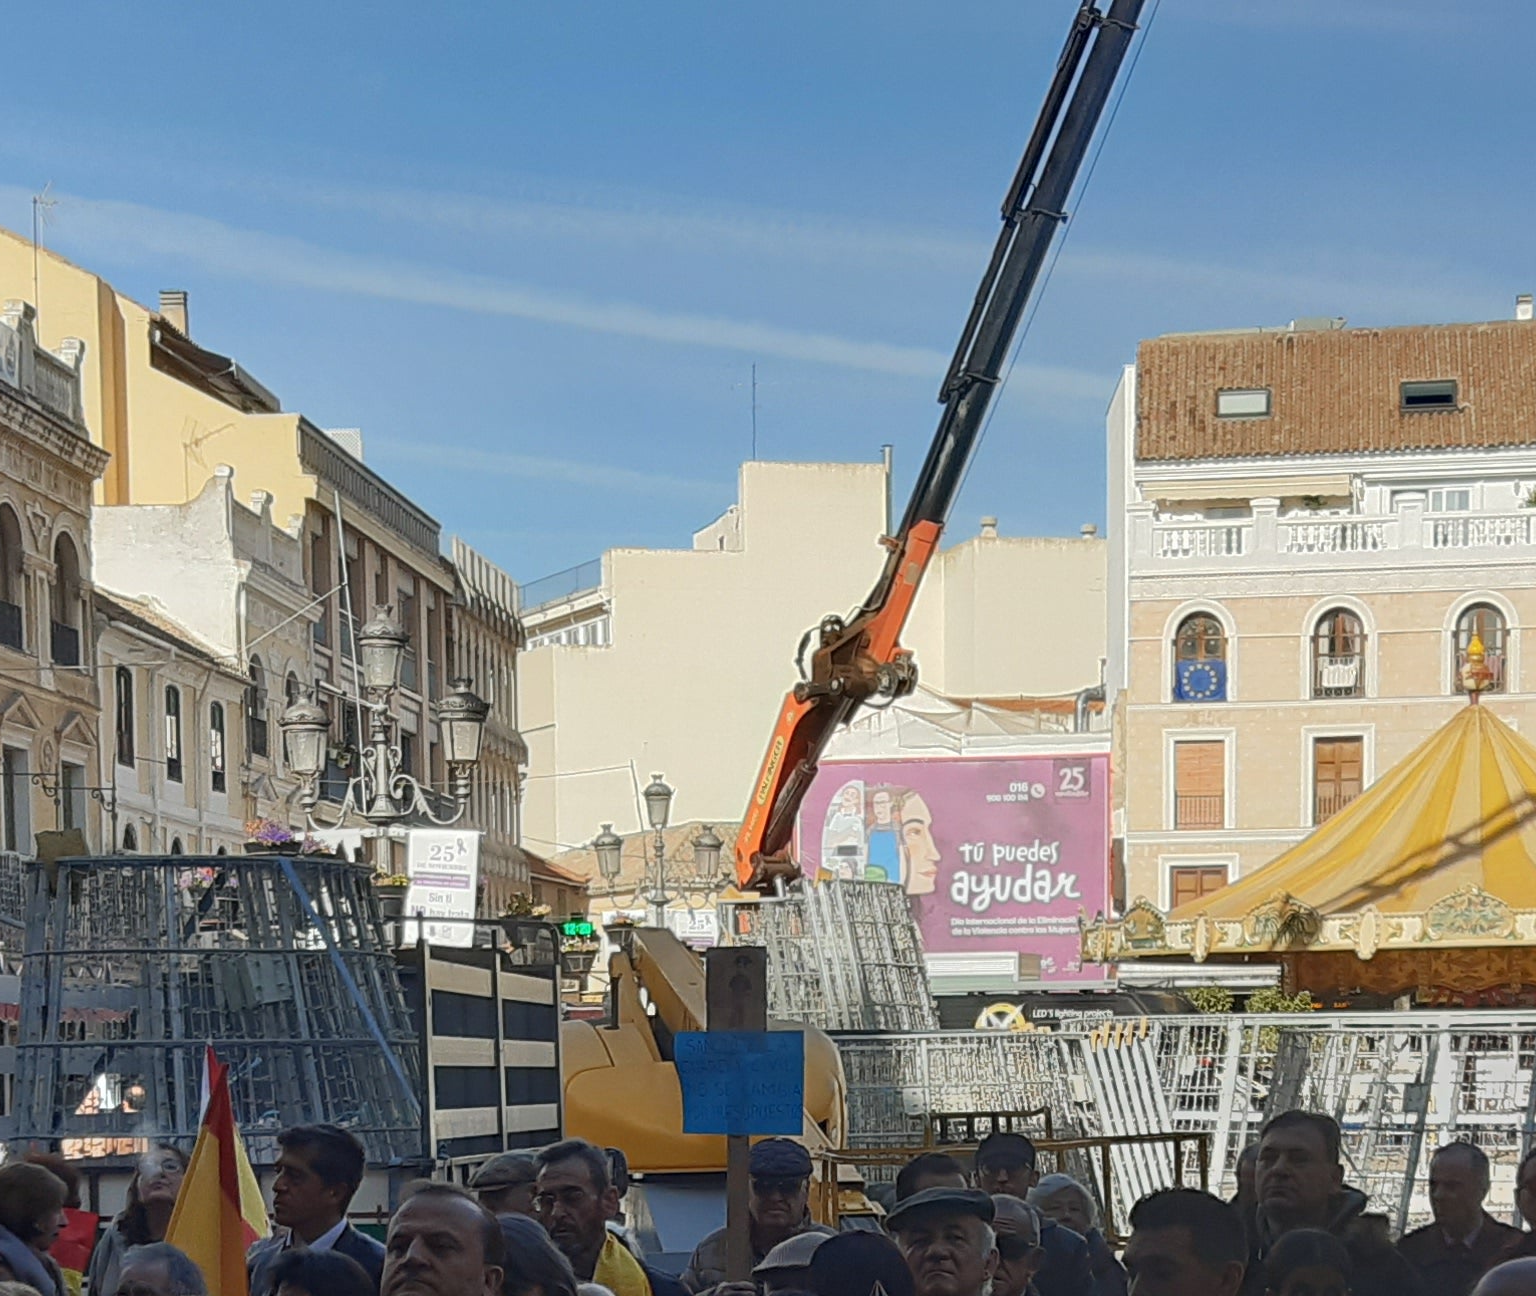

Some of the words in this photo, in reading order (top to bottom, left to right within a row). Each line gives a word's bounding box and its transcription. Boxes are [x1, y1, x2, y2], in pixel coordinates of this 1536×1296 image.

[1059, 767, 1085, 791] 25
[1009, 782, 1029, 793] 016
[430, 844, 455, 863] 25
[992, 839, 1060, 866] puedes
[950, 863, 1081, 912] ayudar
[428, 892, 444, 903] Sin
[966, 916, 1016, 926] Internacional
[1018, 916, 1028, 925] de
[1037, 915, 1079, 925] Eliminació
[952, 927, 962, 936] de
[972, 926, 1007, 936] Violencia
[1009, 926, 1034, 935] contra
